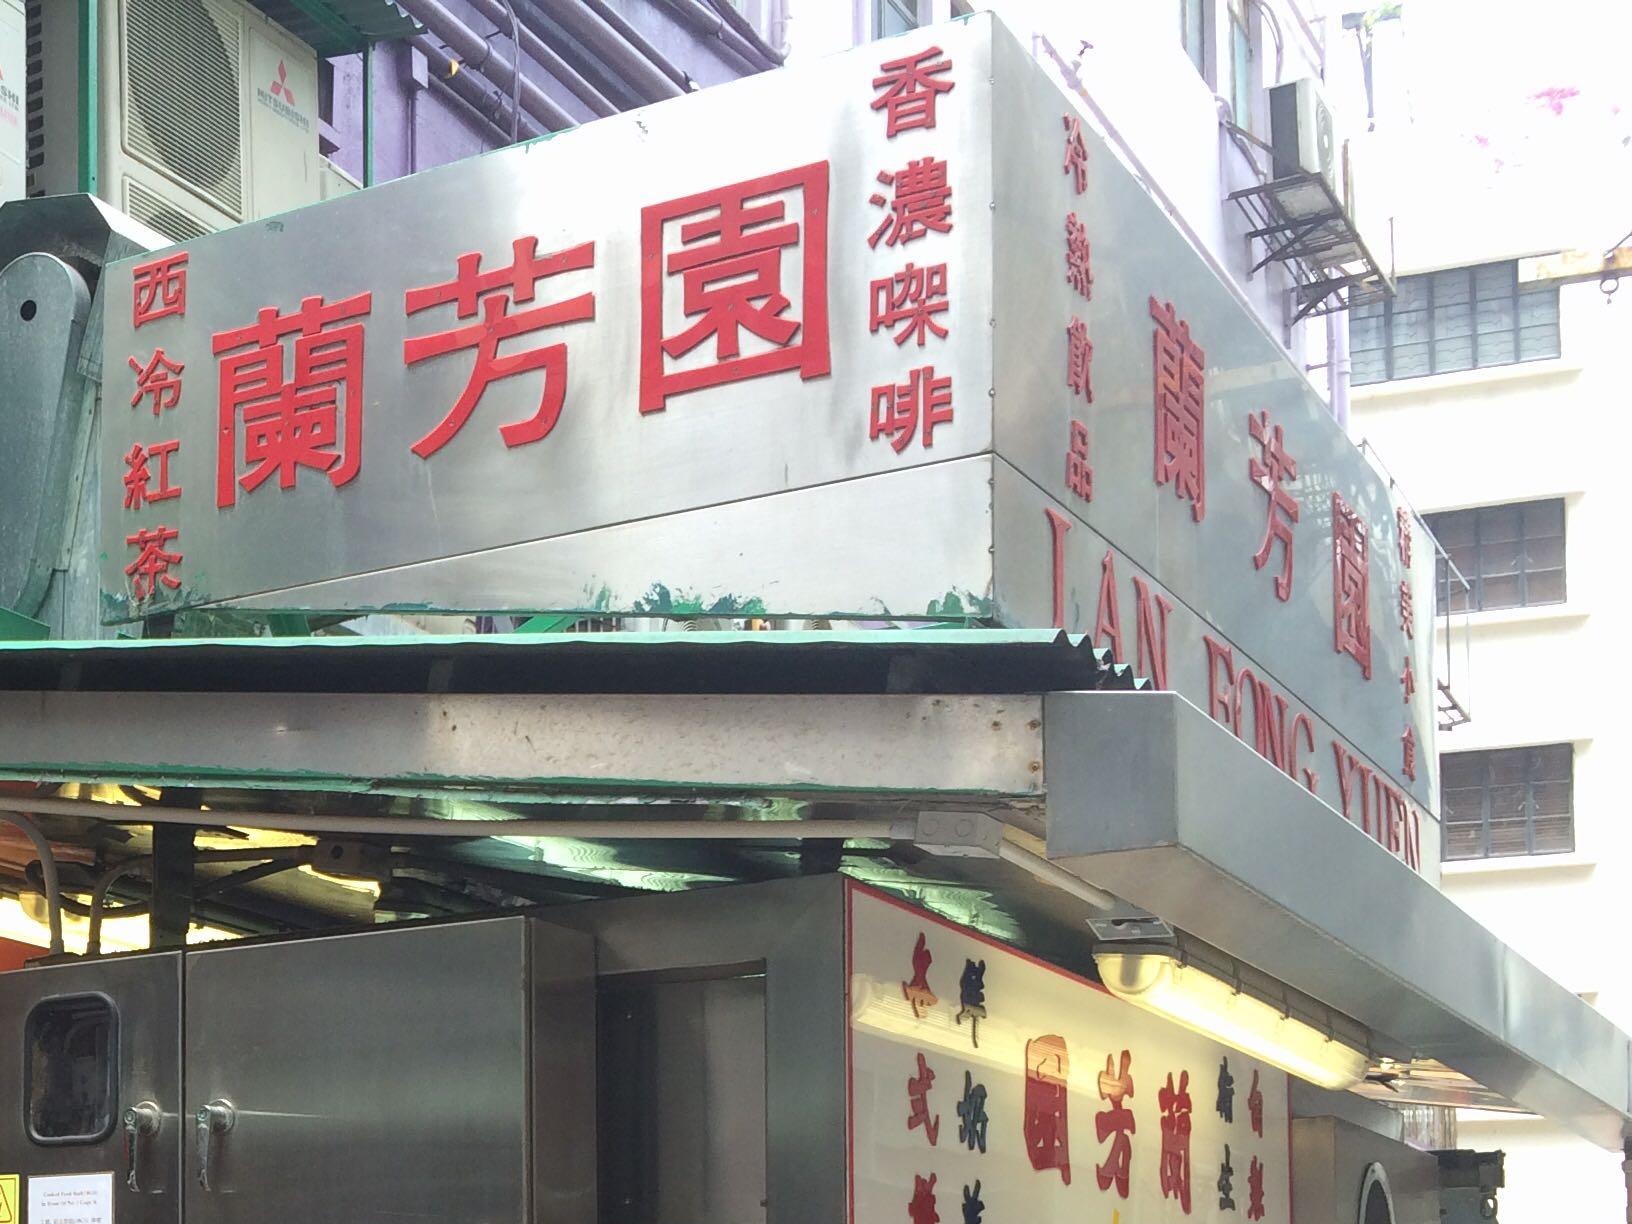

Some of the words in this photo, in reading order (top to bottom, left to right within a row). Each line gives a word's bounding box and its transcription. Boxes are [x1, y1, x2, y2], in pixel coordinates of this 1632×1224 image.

[257, 88, 309, 128] MITSUBISHI
[122, 252, 188, 598] 西冷紅茶
[211, 159, 832, 509] 蘭芳園
[1063, 111, 1094, 503] 冷熱飲品
[1043, 506, 1172, 693] LAN
[1203, 633, 1319, 797] FONG
[1148, 291, 1374, 682] 蘭芳園
